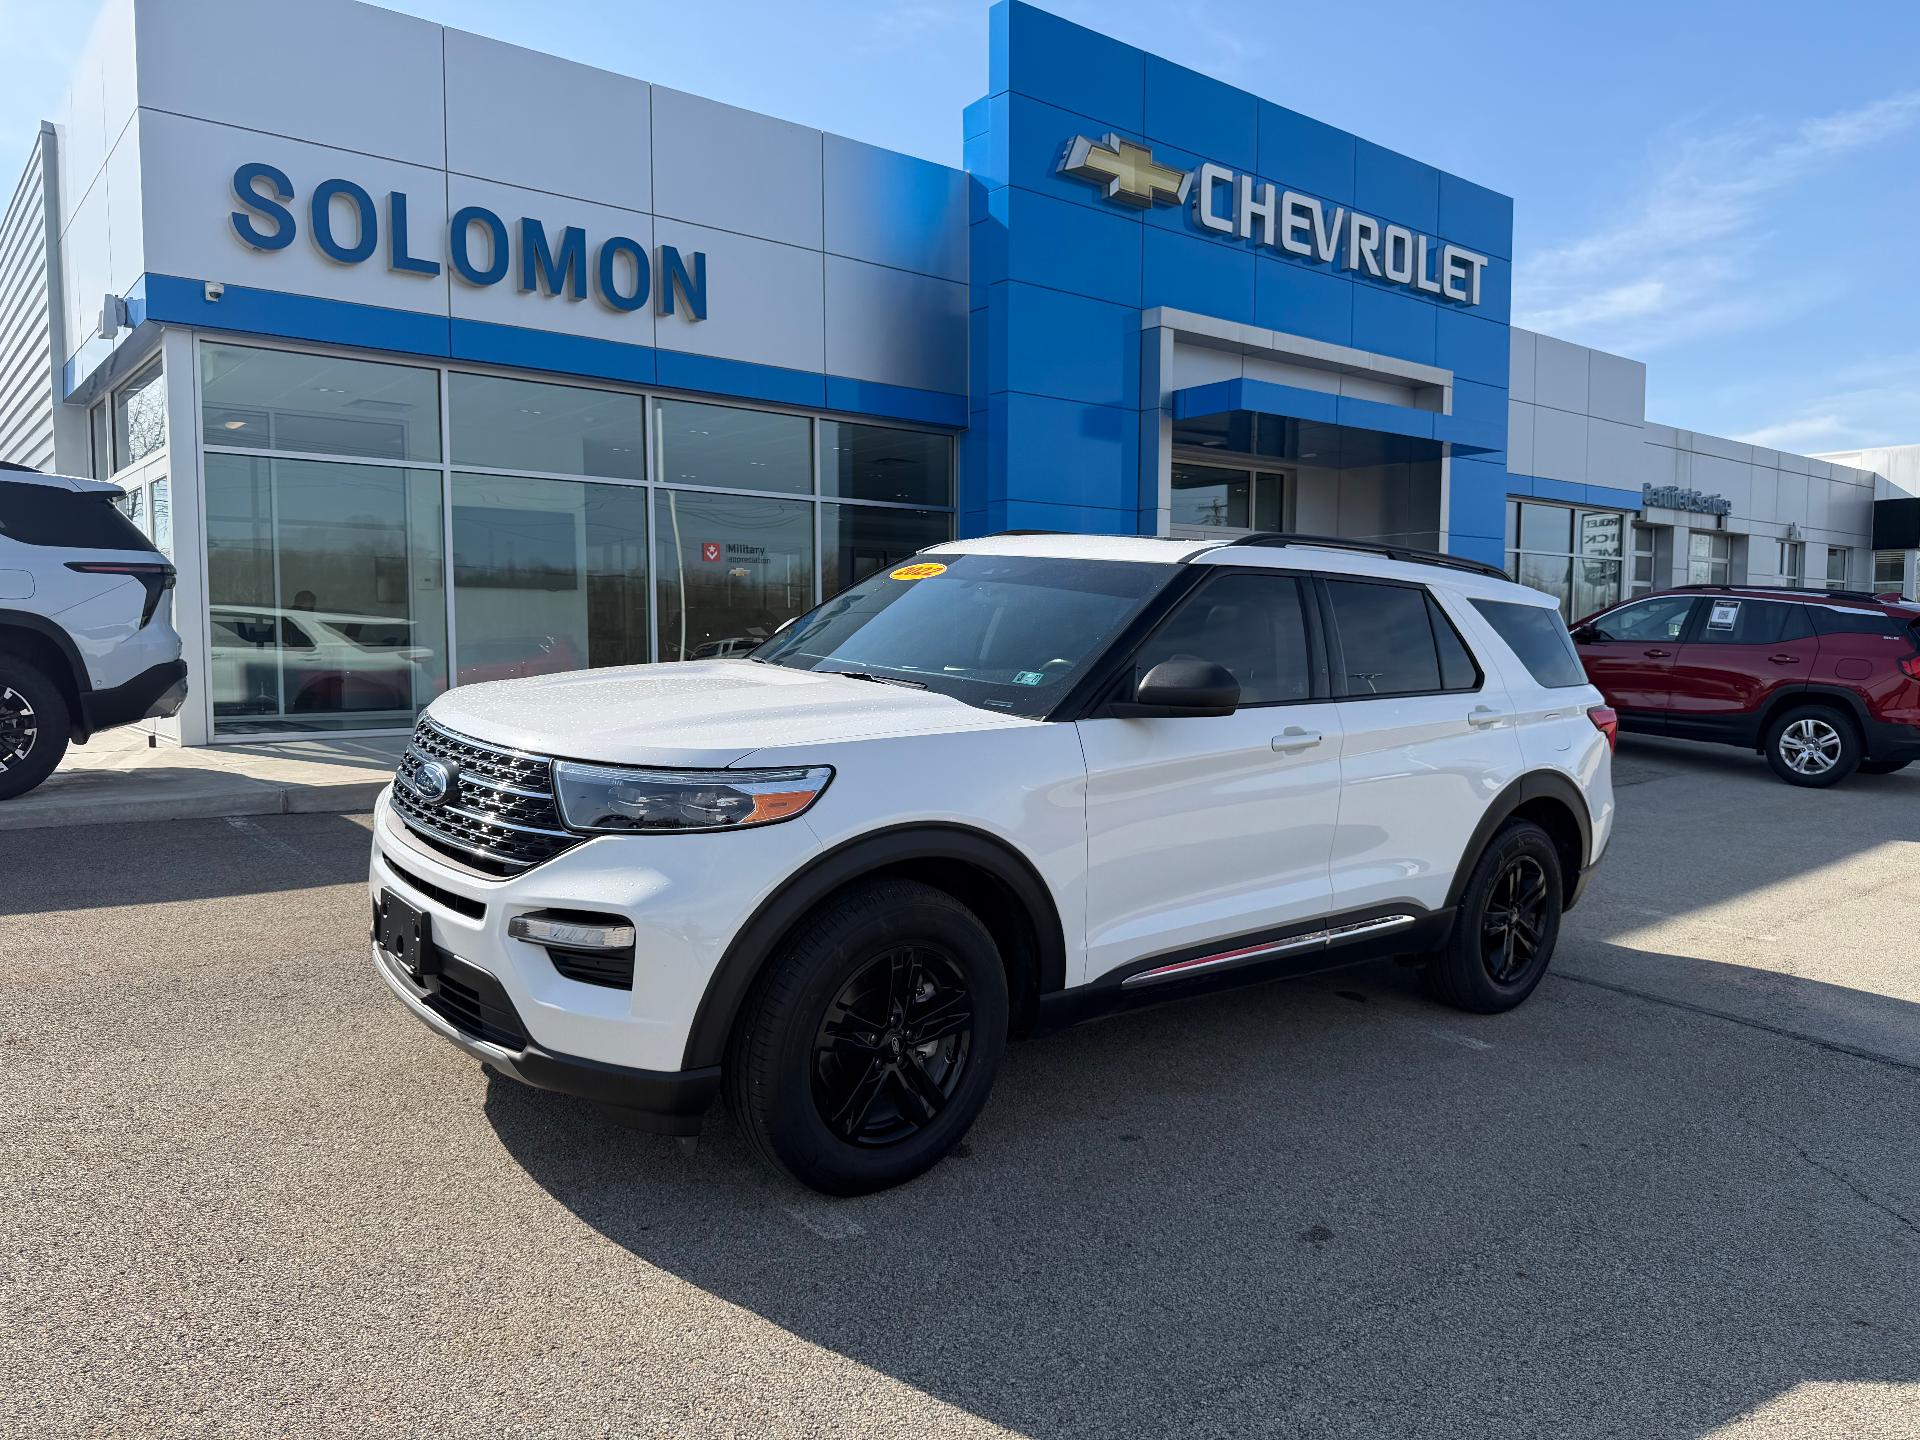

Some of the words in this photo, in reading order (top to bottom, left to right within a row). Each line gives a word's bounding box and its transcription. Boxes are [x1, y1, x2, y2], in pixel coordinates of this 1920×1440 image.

[230, 162, 708, 323] SOLOMON
[1194, 162, 1489, 306] CHEVROLET
[727, 543, 766, 557] Military
